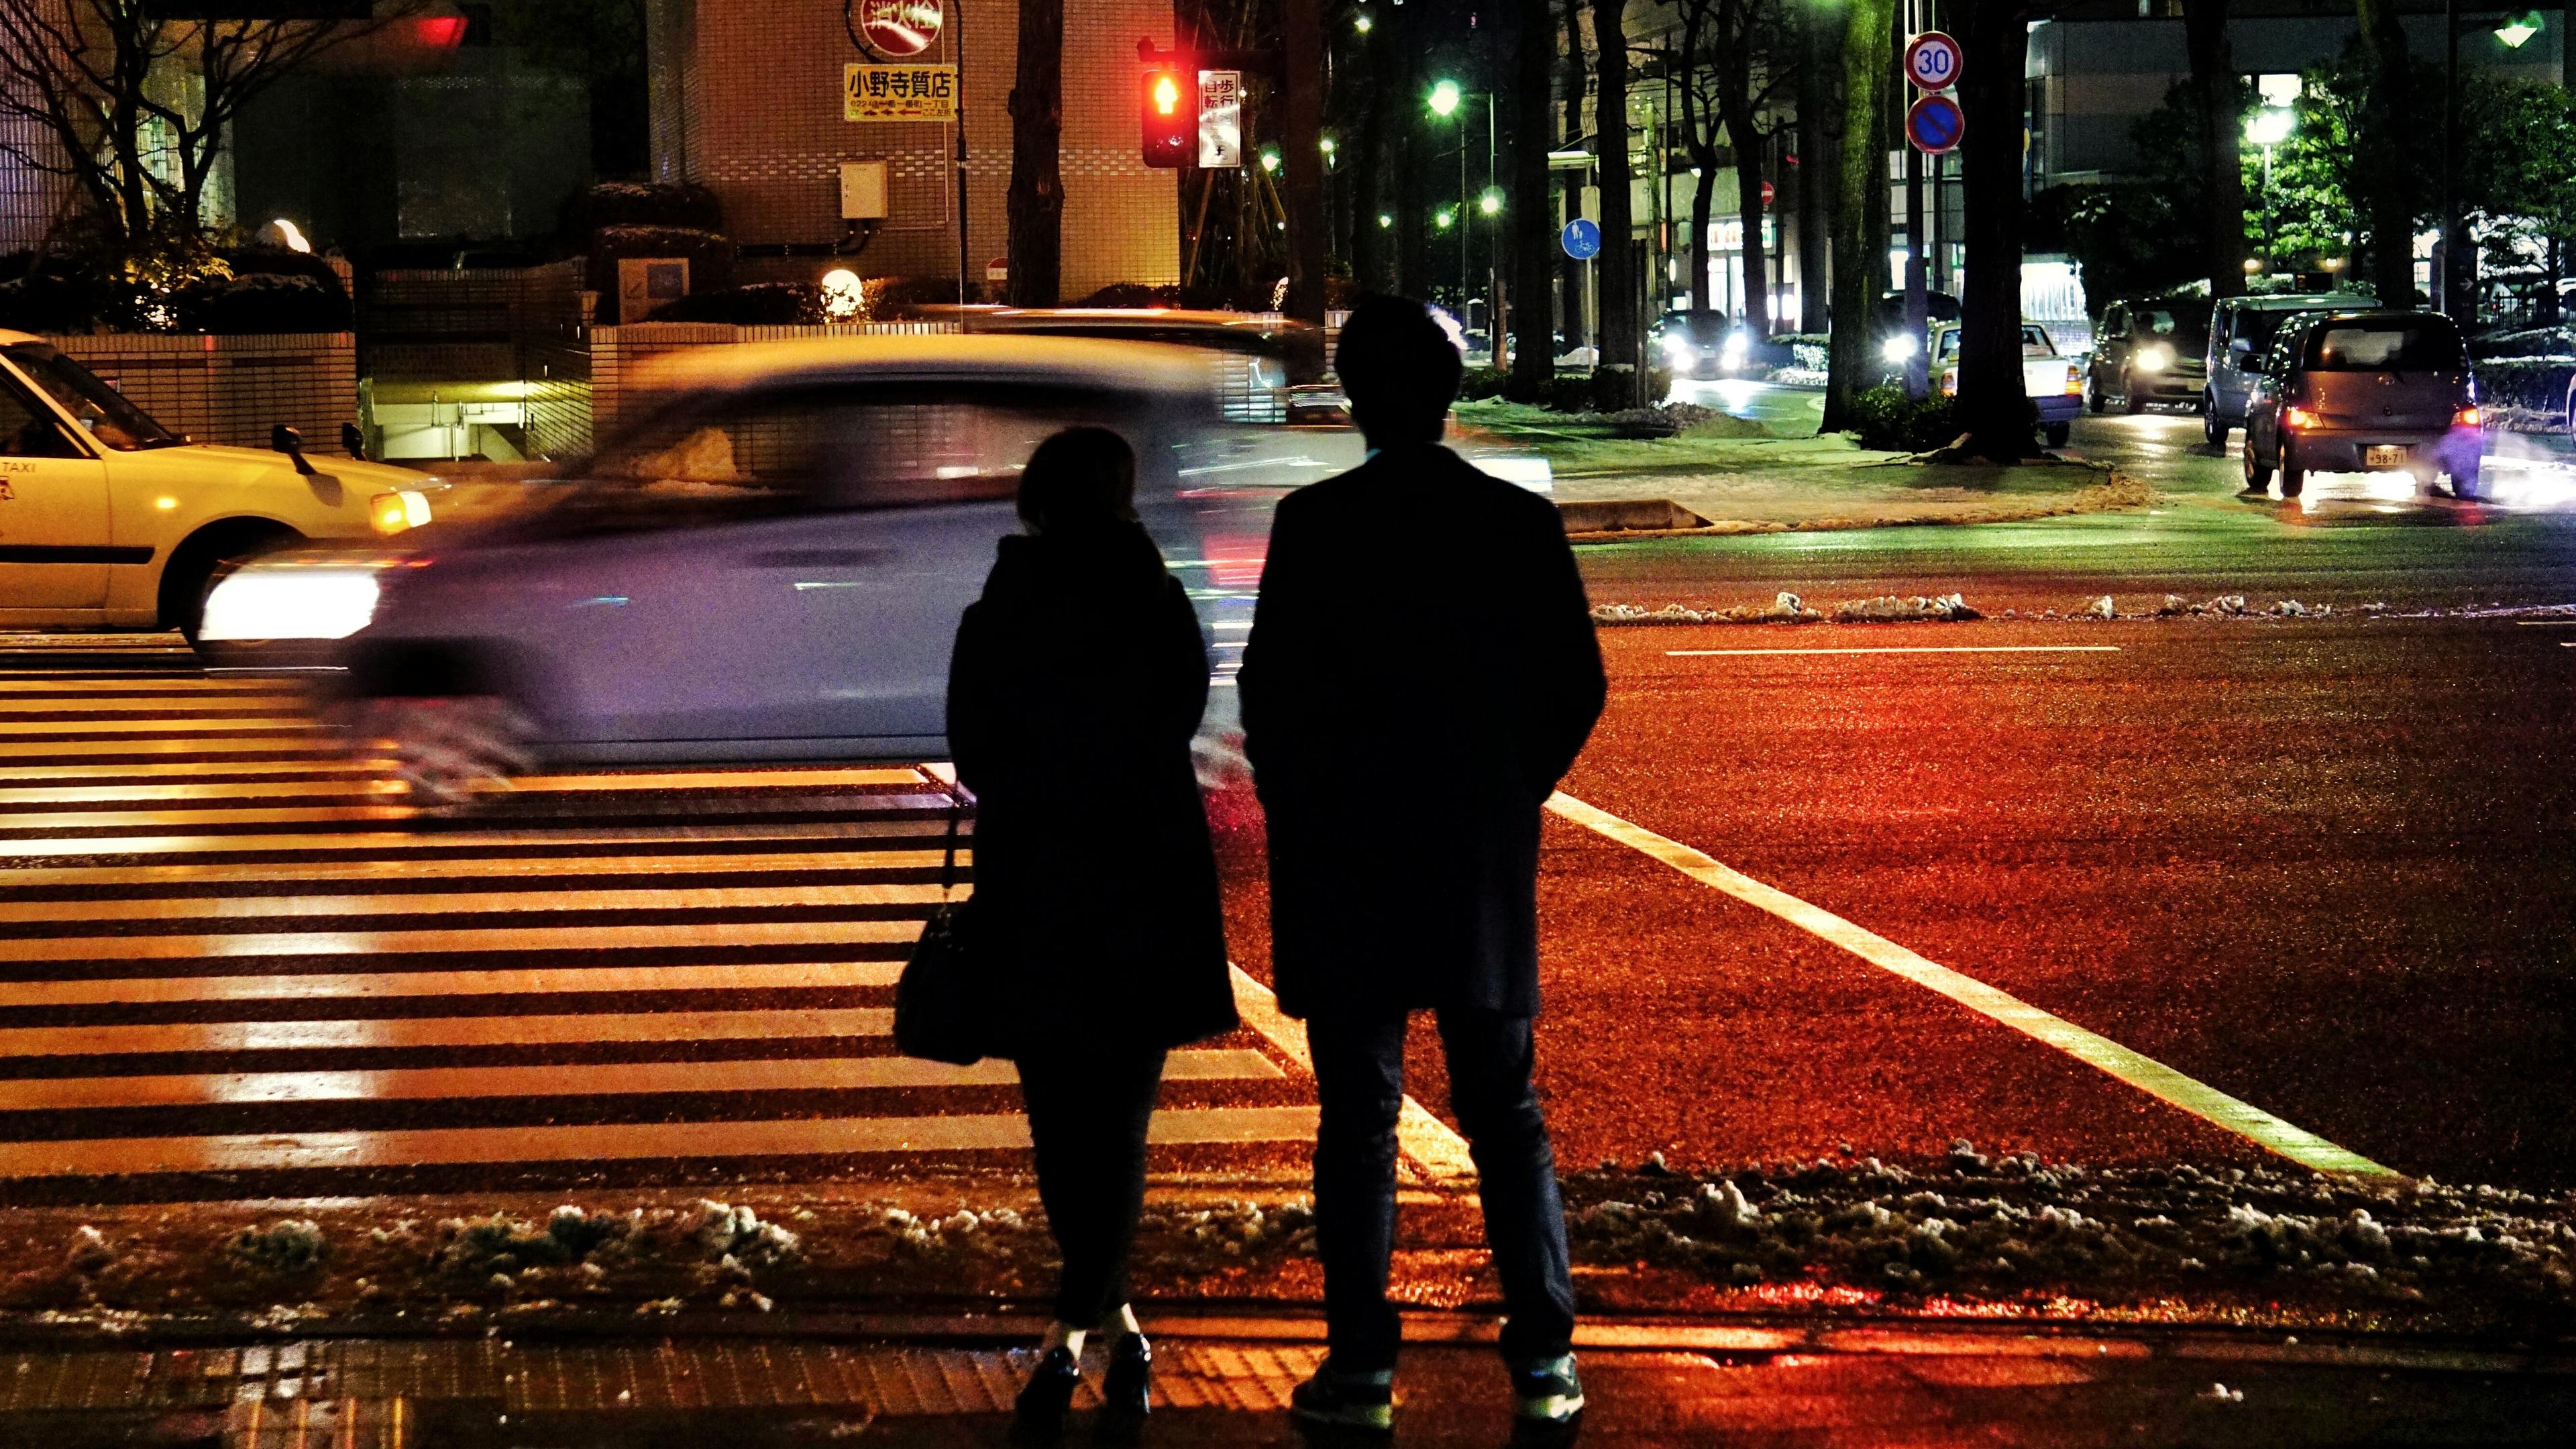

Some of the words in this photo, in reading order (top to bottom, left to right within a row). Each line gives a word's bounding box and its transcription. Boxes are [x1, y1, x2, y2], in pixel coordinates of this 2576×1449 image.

[1919, 49, 1949, 74] 30
[849, 70, 951, 98] 小野寺質店
[2, 462, 36, 473] TAXI
